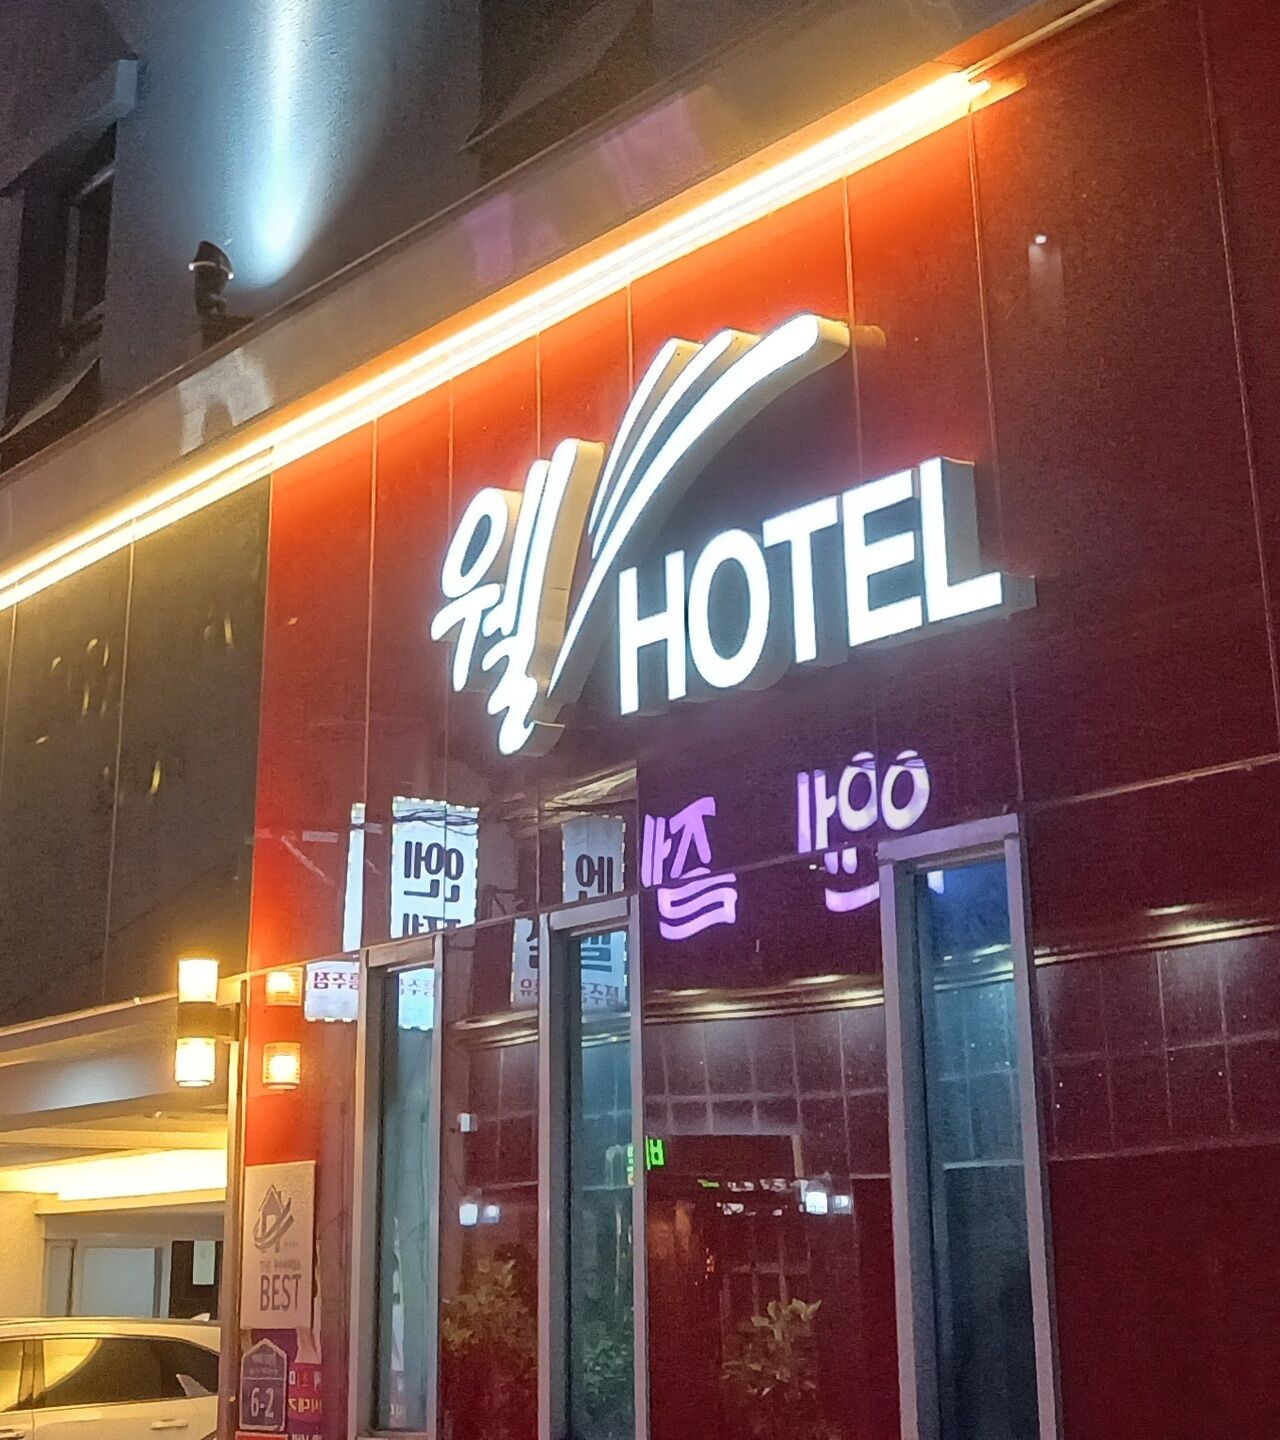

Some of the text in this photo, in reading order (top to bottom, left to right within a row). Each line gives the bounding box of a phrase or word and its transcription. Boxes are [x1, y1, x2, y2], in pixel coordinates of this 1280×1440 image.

[430, 438, 1006, 756] 웰 HOTEL
[259, 1273, 302, 1312] BEST
[250, 1386, 275, 1419] 6-2
